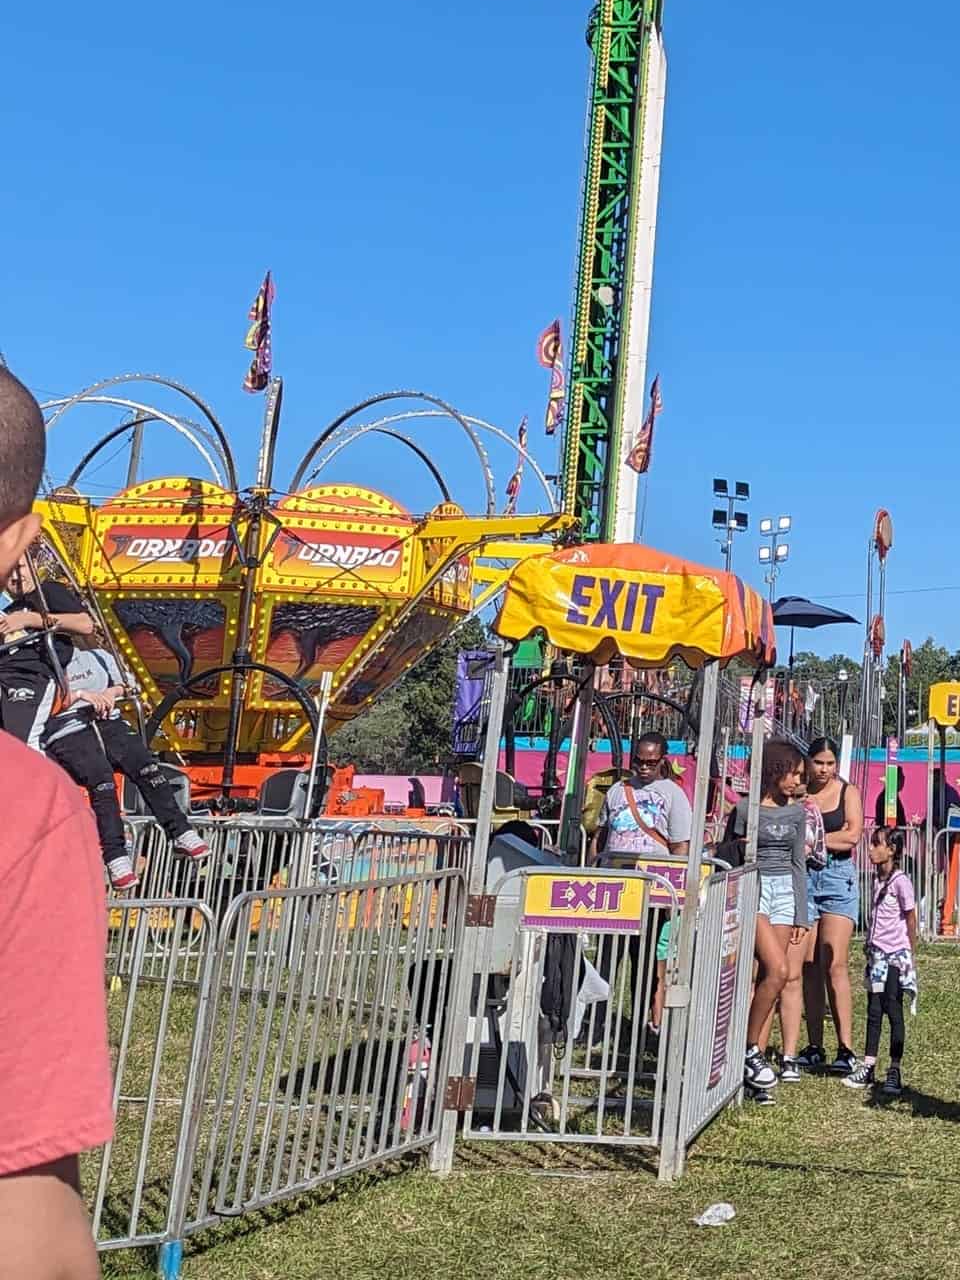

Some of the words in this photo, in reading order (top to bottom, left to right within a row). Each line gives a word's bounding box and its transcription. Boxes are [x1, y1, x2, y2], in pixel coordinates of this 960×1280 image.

[109, 534, 233, 562] TORNADO
[280, 535, 400, 568] TORNADO
[566, 574, 666, 634] EXIT
[549, 879, 625, 913] EXIT
